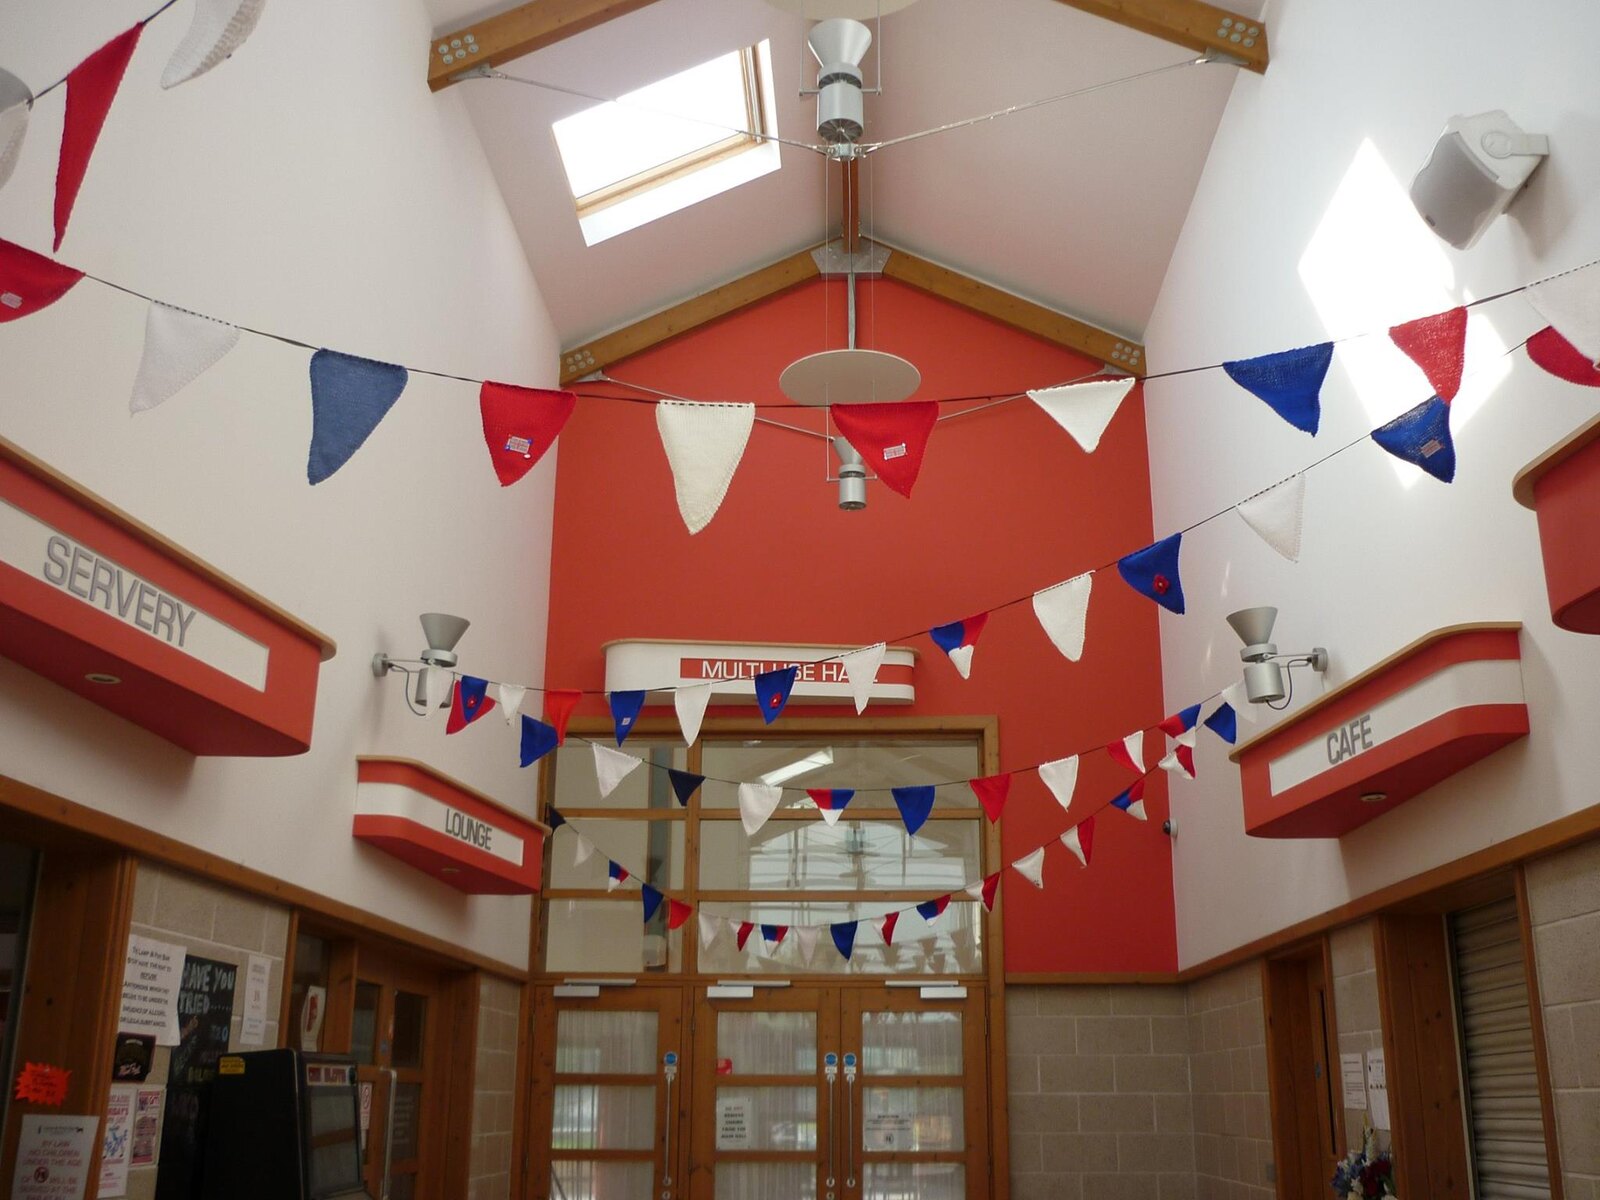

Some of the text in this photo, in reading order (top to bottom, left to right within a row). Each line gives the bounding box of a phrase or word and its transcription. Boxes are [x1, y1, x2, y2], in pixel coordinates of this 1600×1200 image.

[43, 535, 197, 647] SERVERY
[702, 660, 764, 680] MULTI
[1326, 714, 1373, 765] CAFE
[445, 807, 493, 851] LOUNGE
[212, 967, 235, 993] YOU
